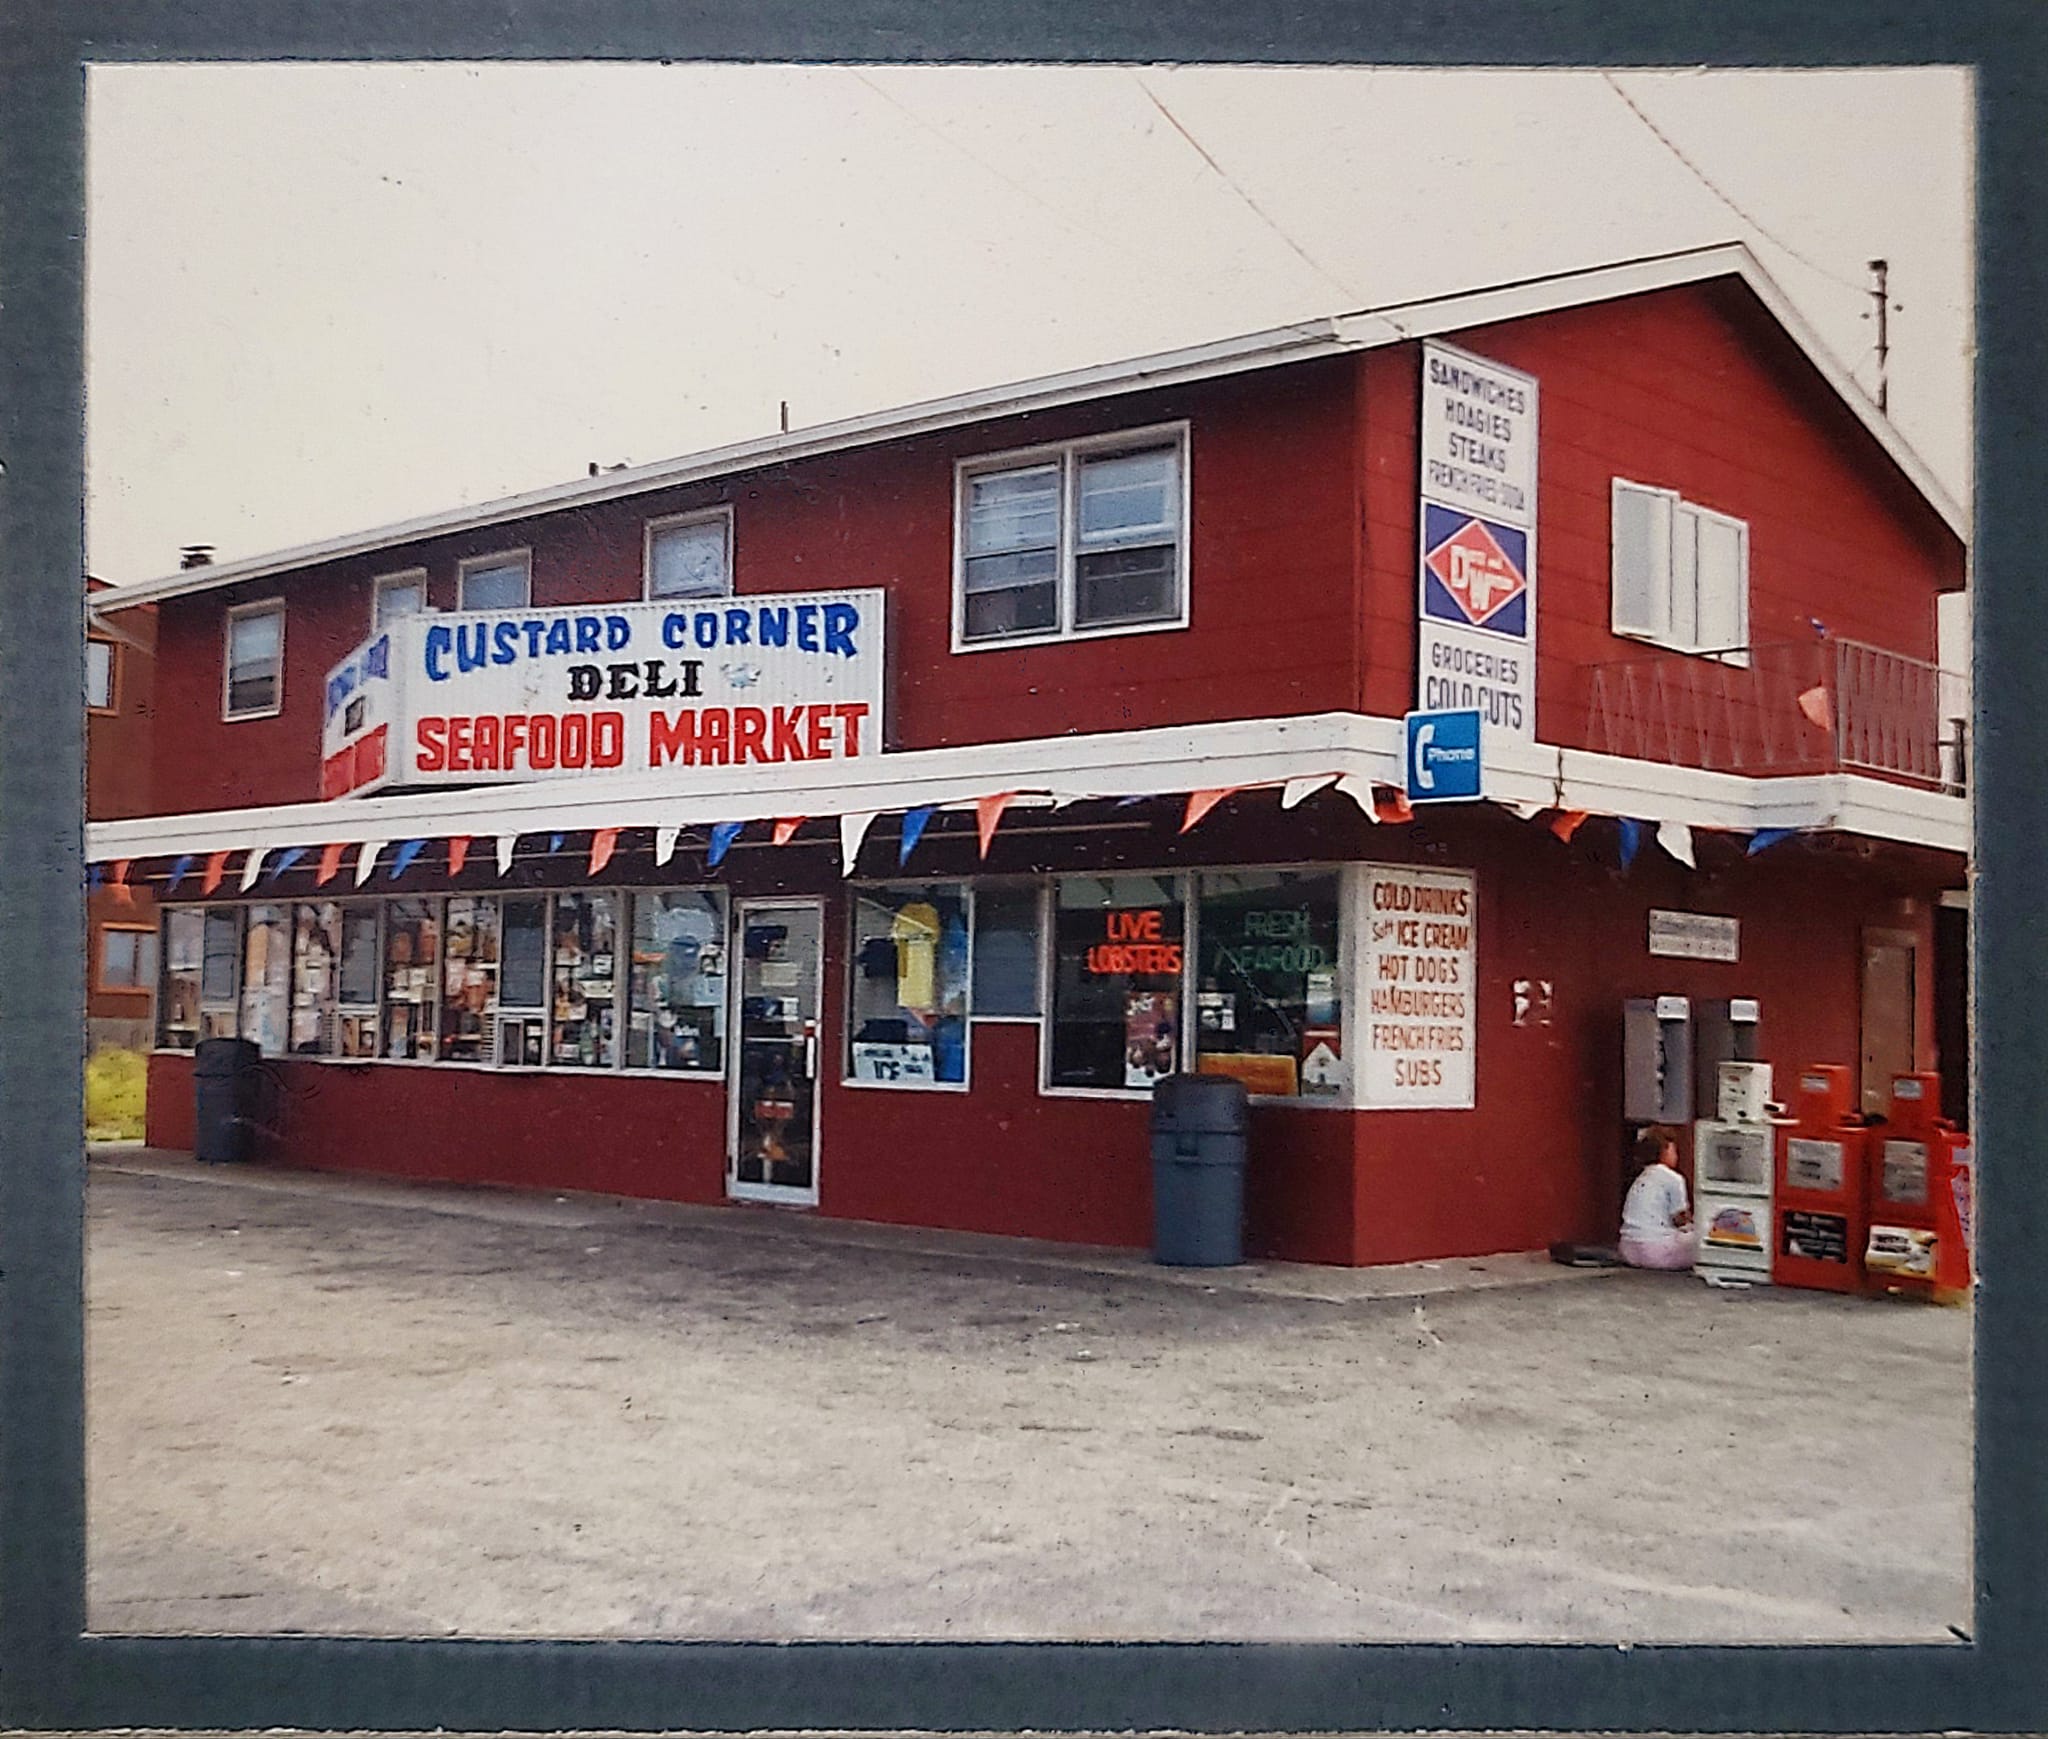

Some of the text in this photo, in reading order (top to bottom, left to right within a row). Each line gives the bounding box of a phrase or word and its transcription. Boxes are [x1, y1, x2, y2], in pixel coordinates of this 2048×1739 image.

[1429, 358, 1525, 415] SANDWICHES
[1446, 397, 1511, 443] HOAGIES
[1449, 432, 1506, 474] STEAKS
[425, 616, 631, 682] CUSTARD
[662, 603, 860, 660] CORNER
[567, 660, 704, 702] DELI
[1432, 642, 1519, 686] GROCERIES
[416, 712, 625, 772] SEAFOOD
[649, 703, 869, 768] MARKET
[1373, 881, 1469, 917] COLD DRINKS
[1106, 910, 1163, 940] LIVE
[1396, 919, 1419, 948] ICE
[1424, 922, 1468, 950] CREAM
[1087, 944, 1181, 974] LOBSTERS
[1378, 954, 1459, 984] HOT DOGS
[1371, 986, 1465, 1019] HAMBURGERS
[1372, 1024, 1464, 1052] FRENCH FRIES
[1395, 1059, 1442, 1087] SUBS
